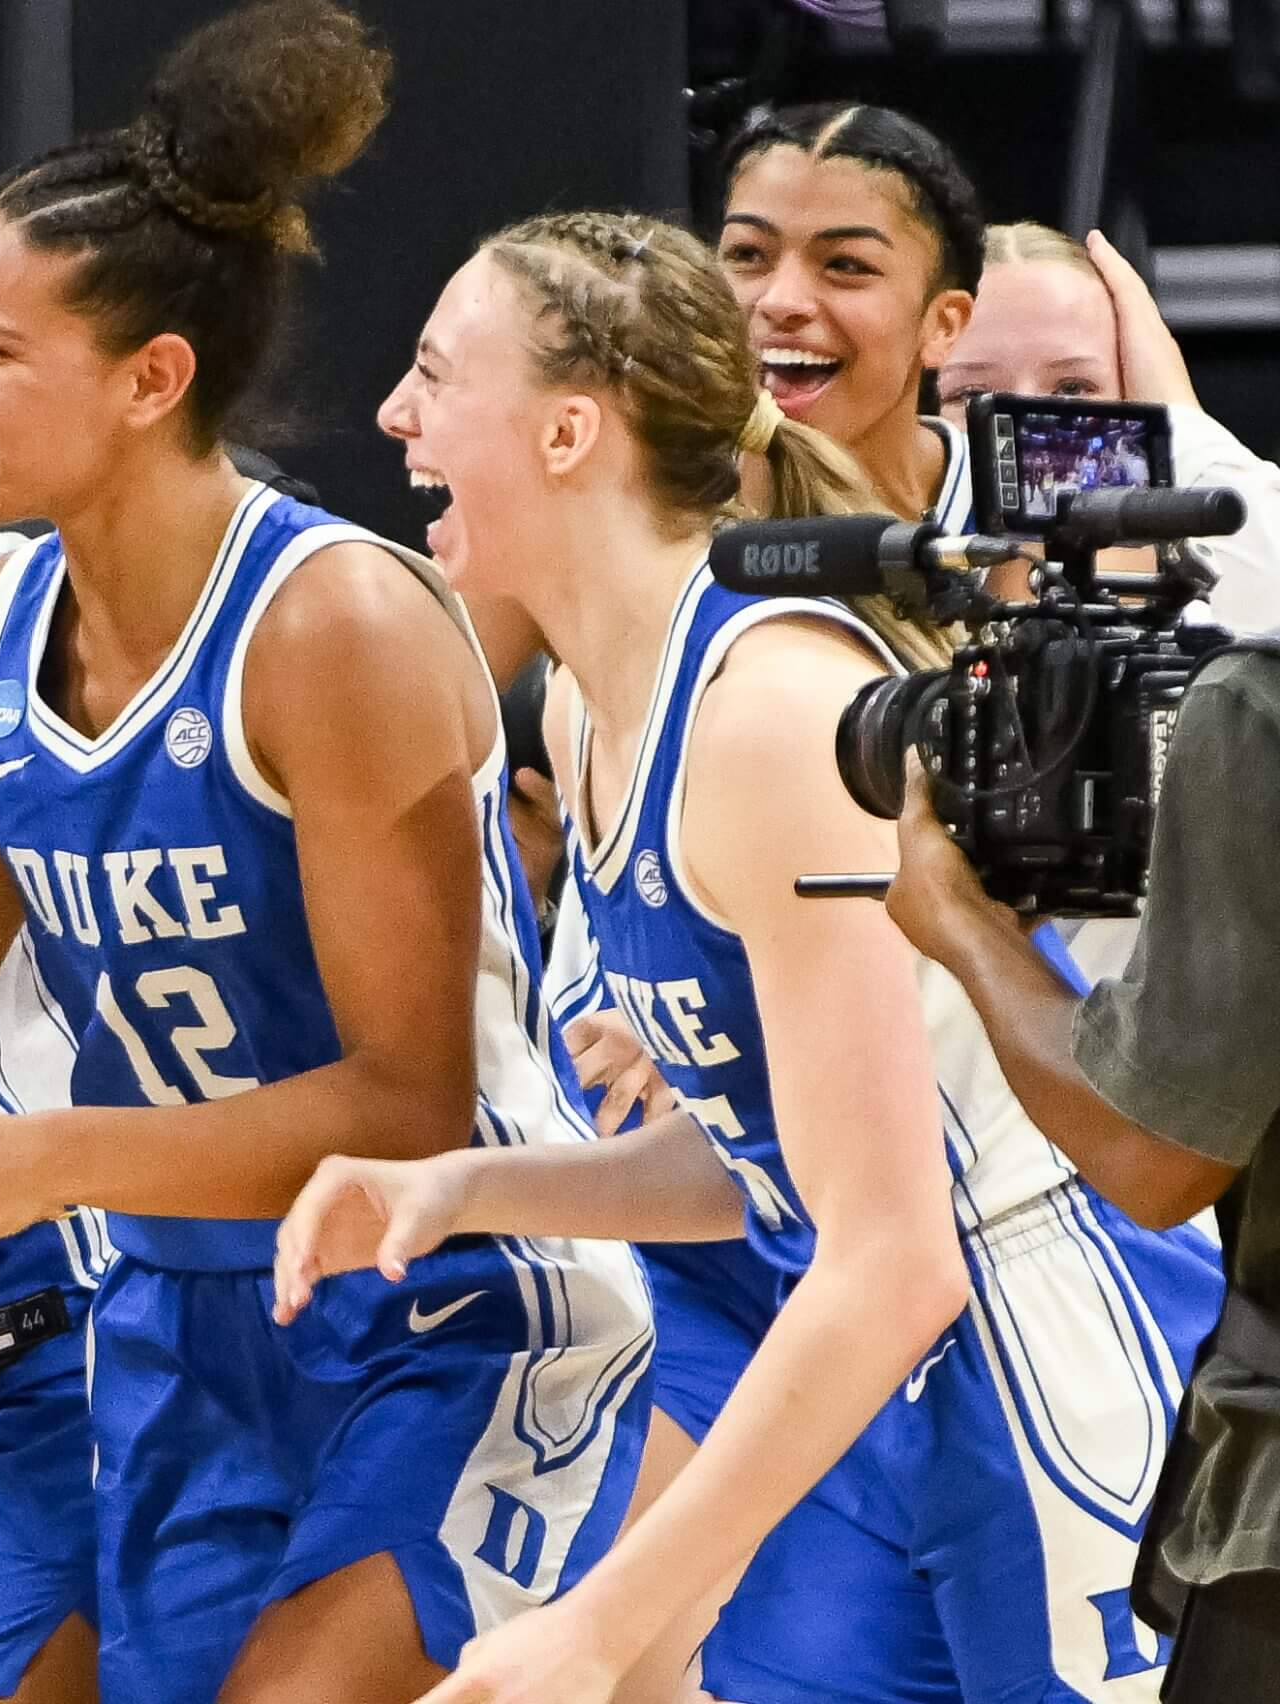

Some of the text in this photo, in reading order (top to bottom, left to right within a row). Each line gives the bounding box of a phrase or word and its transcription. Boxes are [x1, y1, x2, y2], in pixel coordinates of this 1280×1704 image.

[174, 725, 208, 741] ACC
[7, 845, 247, 947] DUKE
[96, 966, 263, 1106] 12
